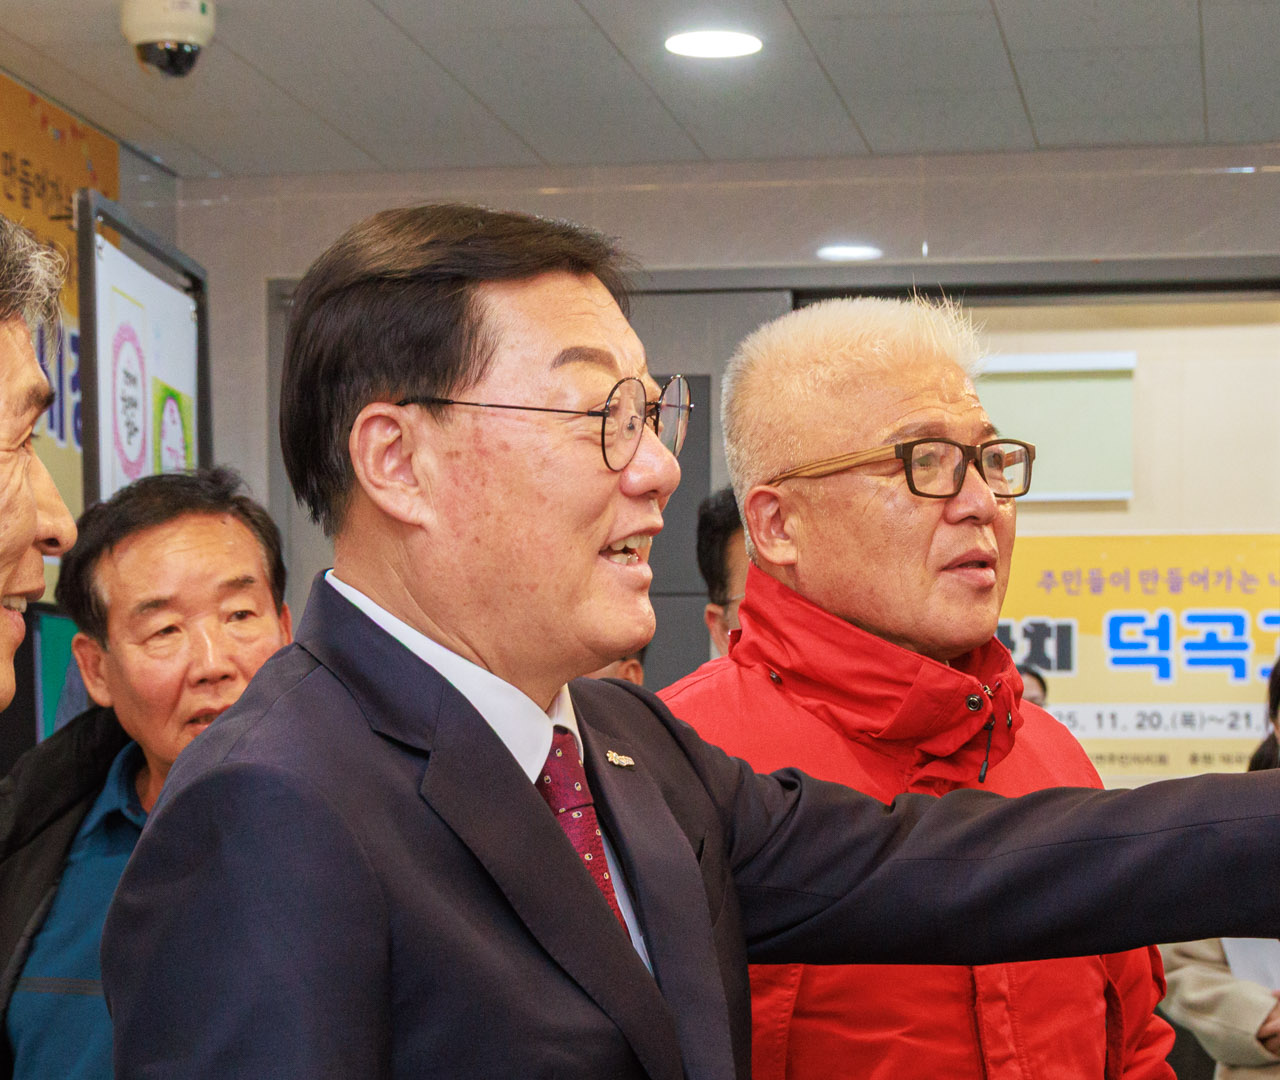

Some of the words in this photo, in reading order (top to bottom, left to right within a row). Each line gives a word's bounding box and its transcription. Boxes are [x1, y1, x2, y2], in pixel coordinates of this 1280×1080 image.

[1037, 567, 1131, 597] 주민들이
[1138, 566, 1260, 597] 만들어가는
[1095, 711, 1128, 732] 11.
